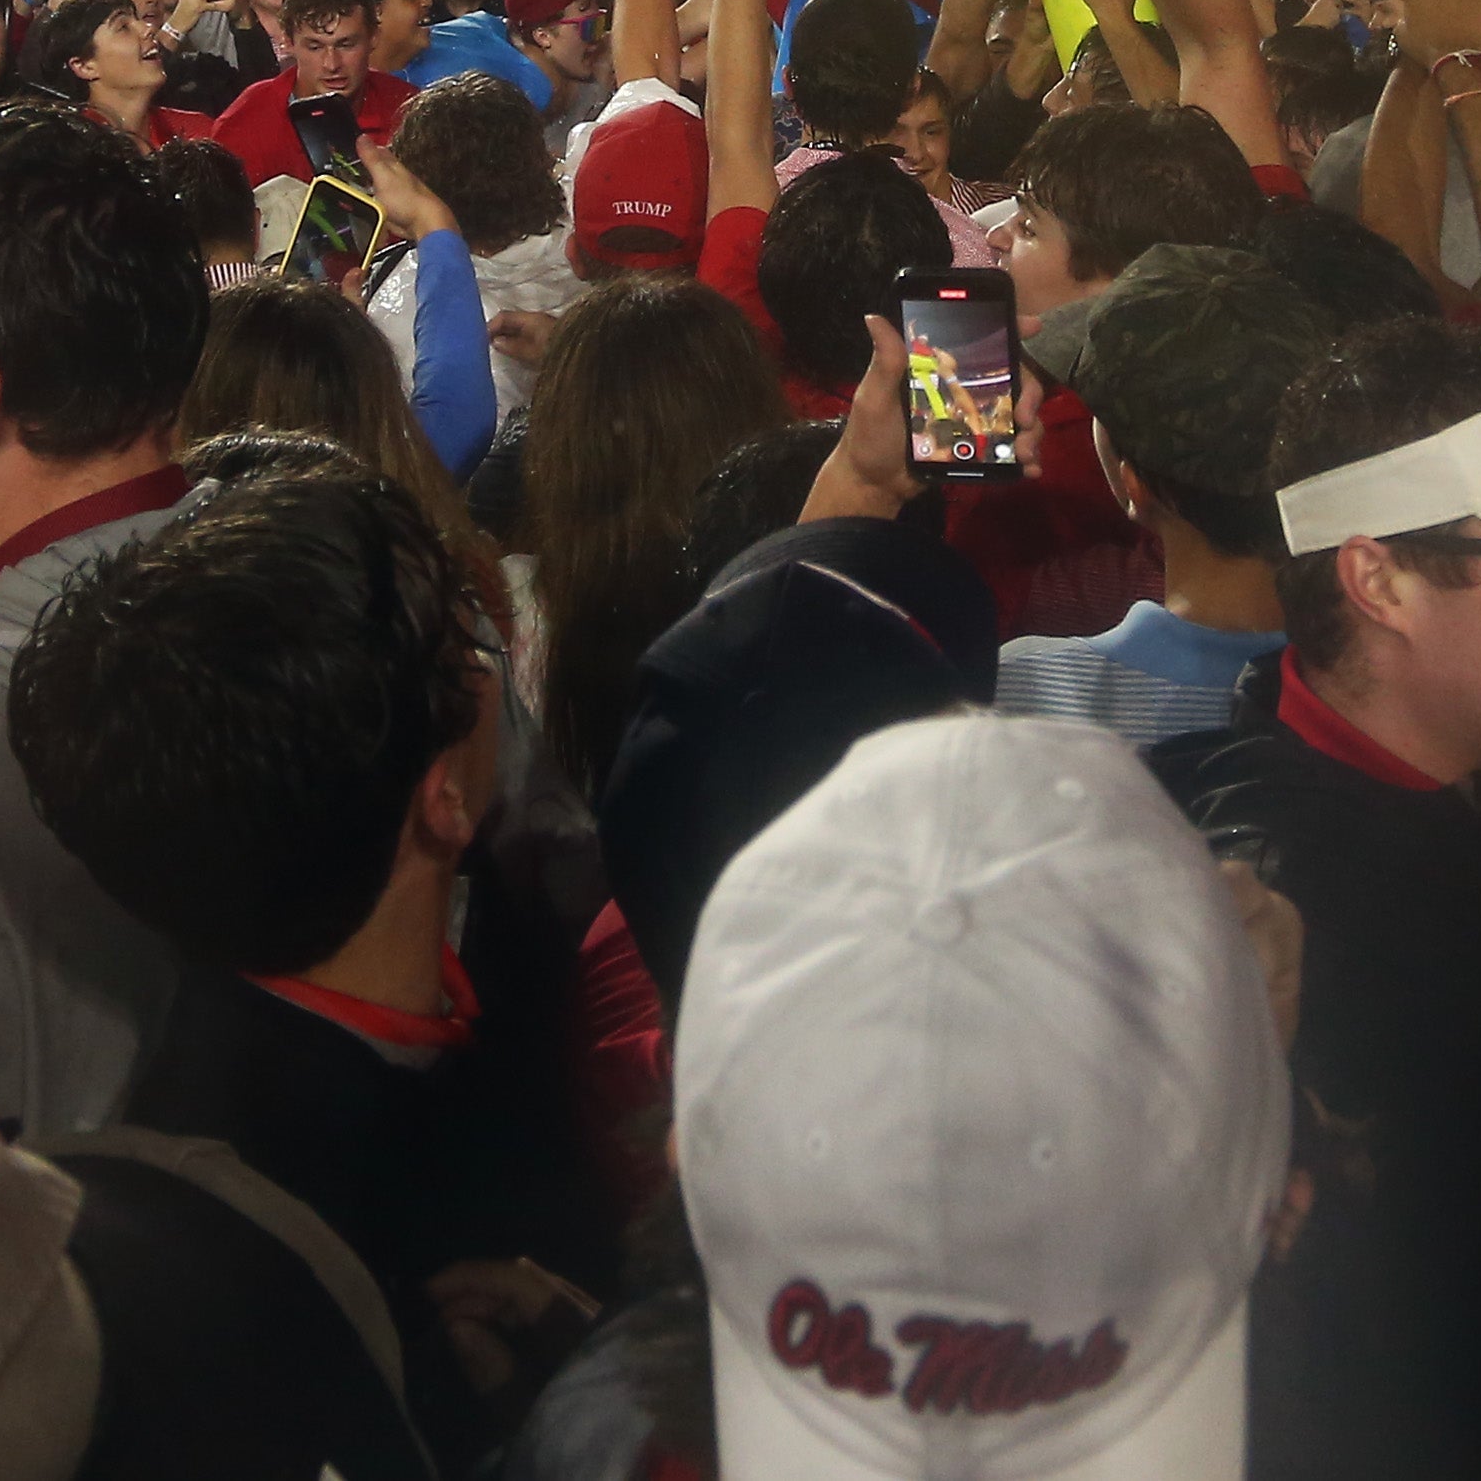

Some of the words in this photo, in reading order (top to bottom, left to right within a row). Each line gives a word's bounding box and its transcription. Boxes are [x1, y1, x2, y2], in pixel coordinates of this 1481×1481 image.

[612, 200, 672, 218] TRUMP
[768, 1275, 896, 1401] Ole
[895, 1311, 1131, 1416] Miss
